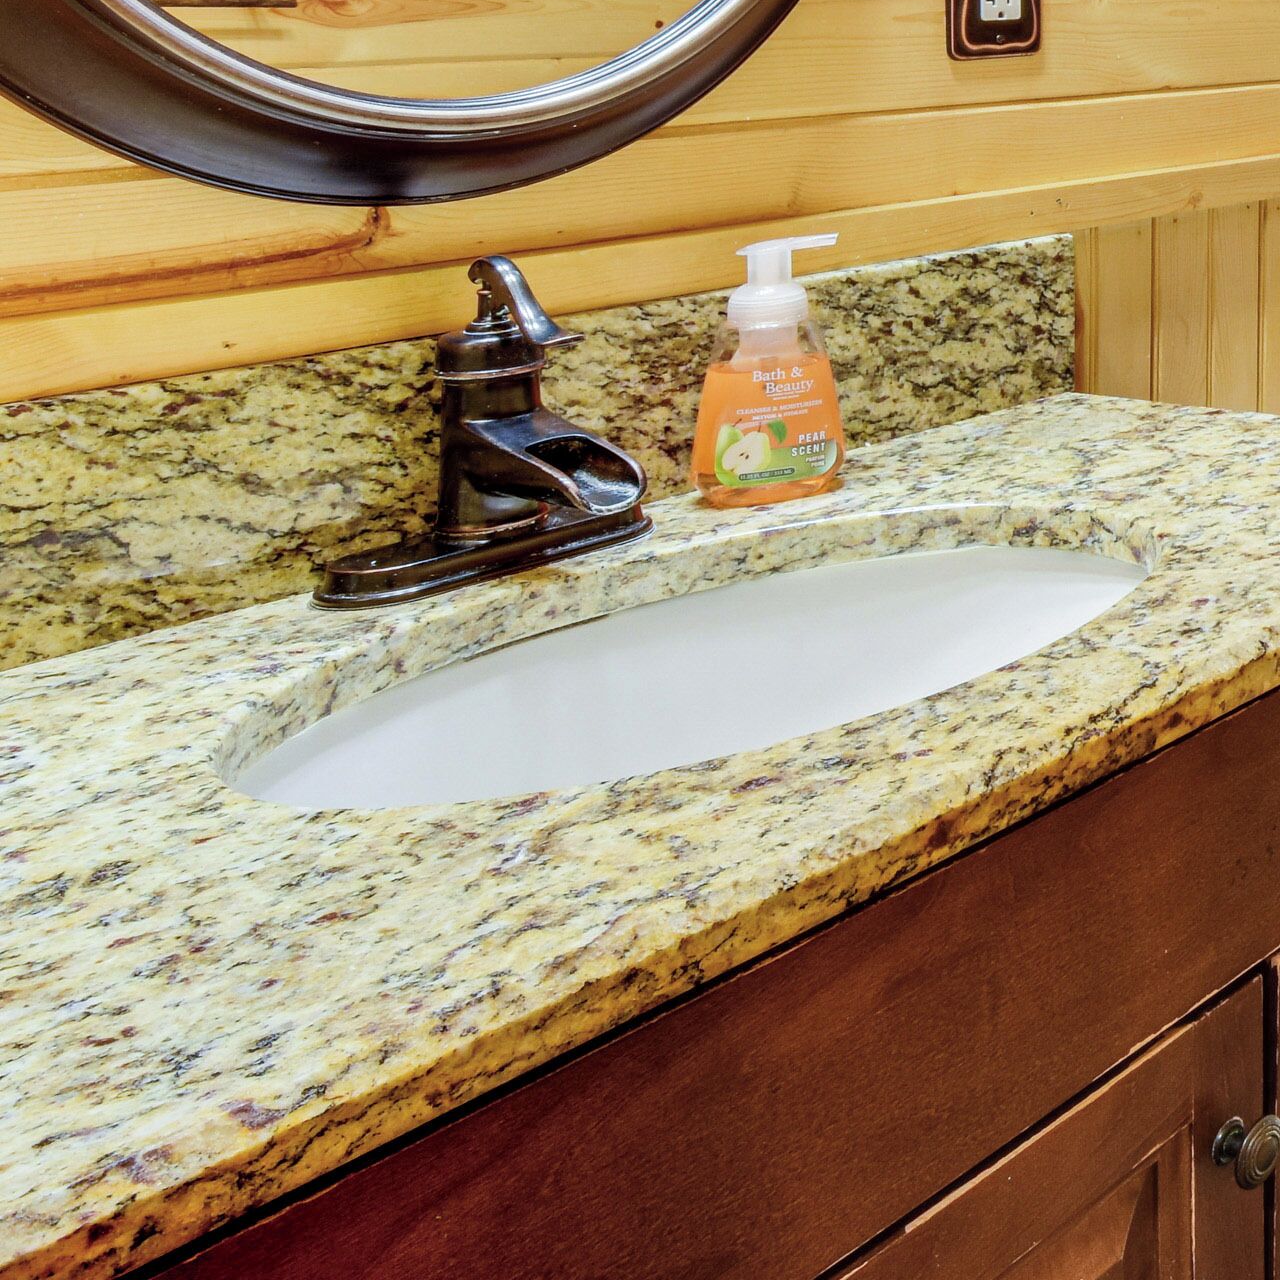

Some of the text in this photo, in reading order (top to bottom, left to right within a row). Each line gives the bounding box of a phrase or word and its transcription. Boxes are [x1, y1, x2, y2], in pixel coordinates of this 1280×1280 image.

[752, 366, 804, 382] Bath &
[766, 379, 814, 394] Beauty
[799, 431, 826, 444] PEAR
[791, 442, 826, 457] SCENT
